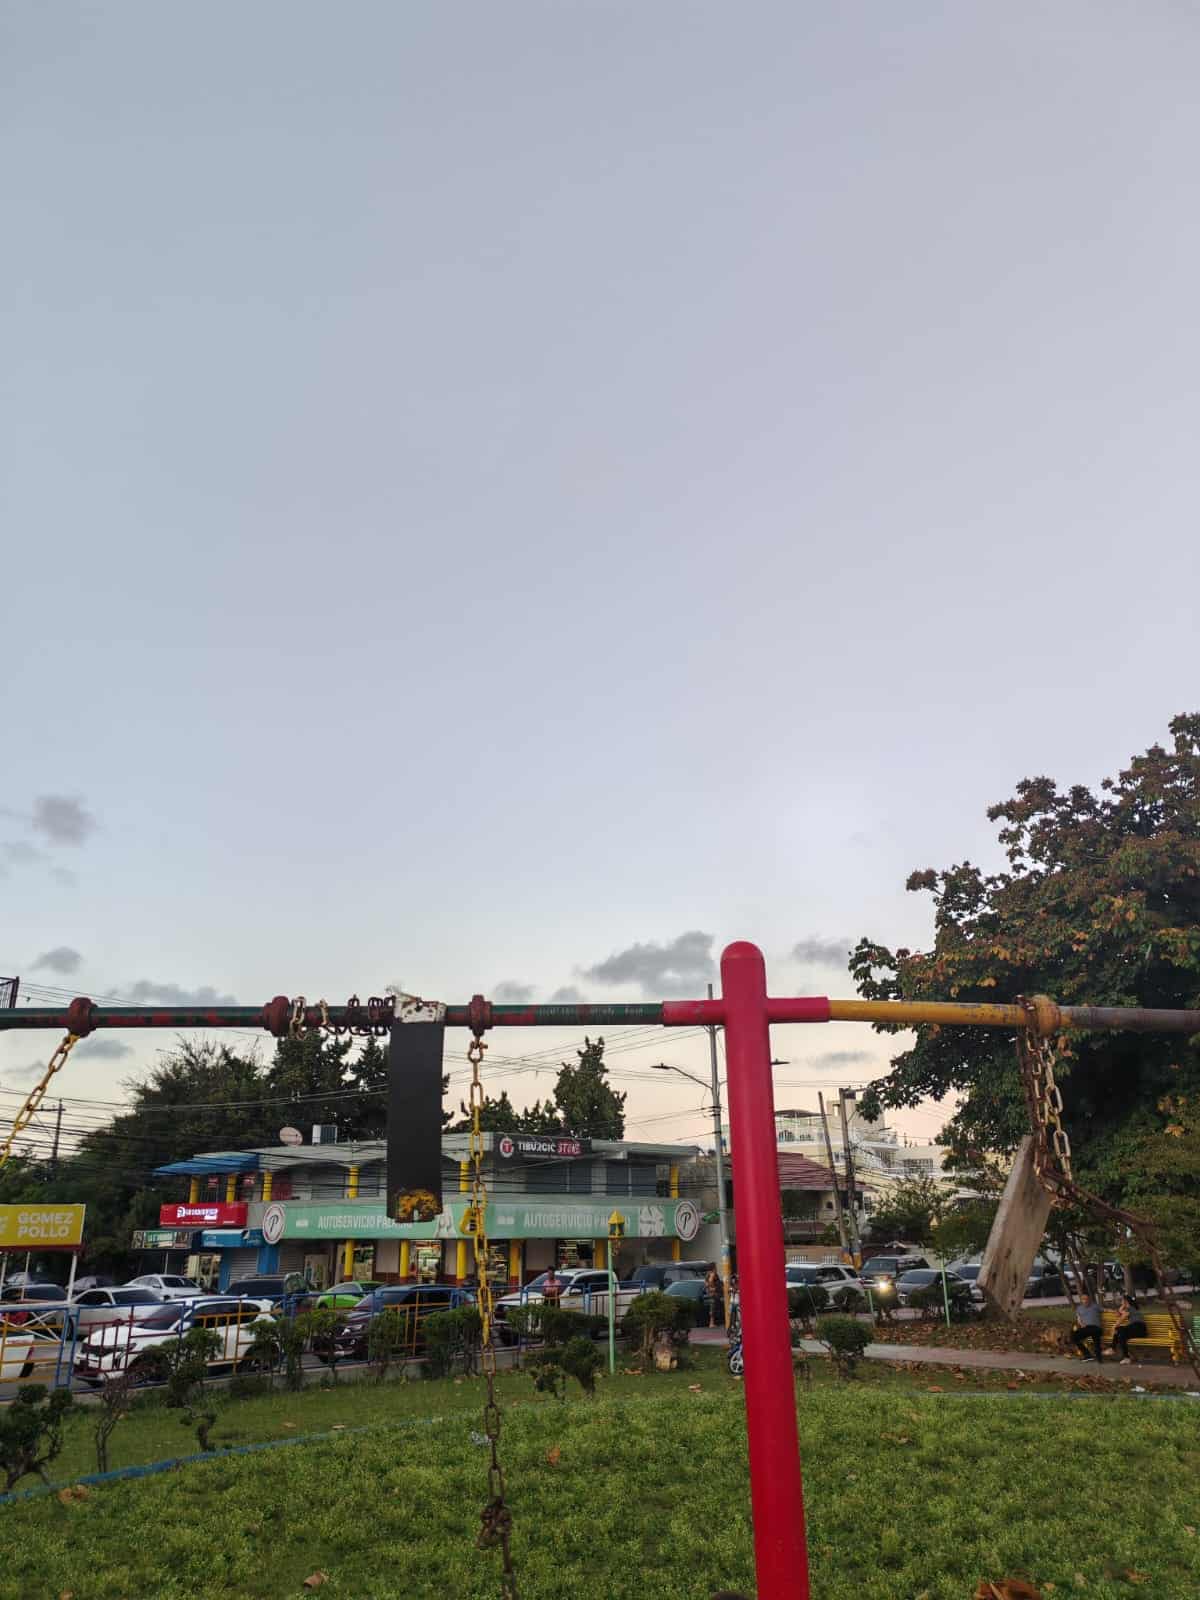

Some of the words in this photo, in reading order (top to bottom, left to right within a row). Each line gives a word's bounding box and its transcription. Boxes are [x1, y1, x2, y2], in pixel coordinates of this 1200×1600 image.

[17, 1211, 74, 1225] GOMEZ
[317, 1215, 376, 1230] AUTOSERVICIO
[17, 1225, 71, 1238] POLLO
